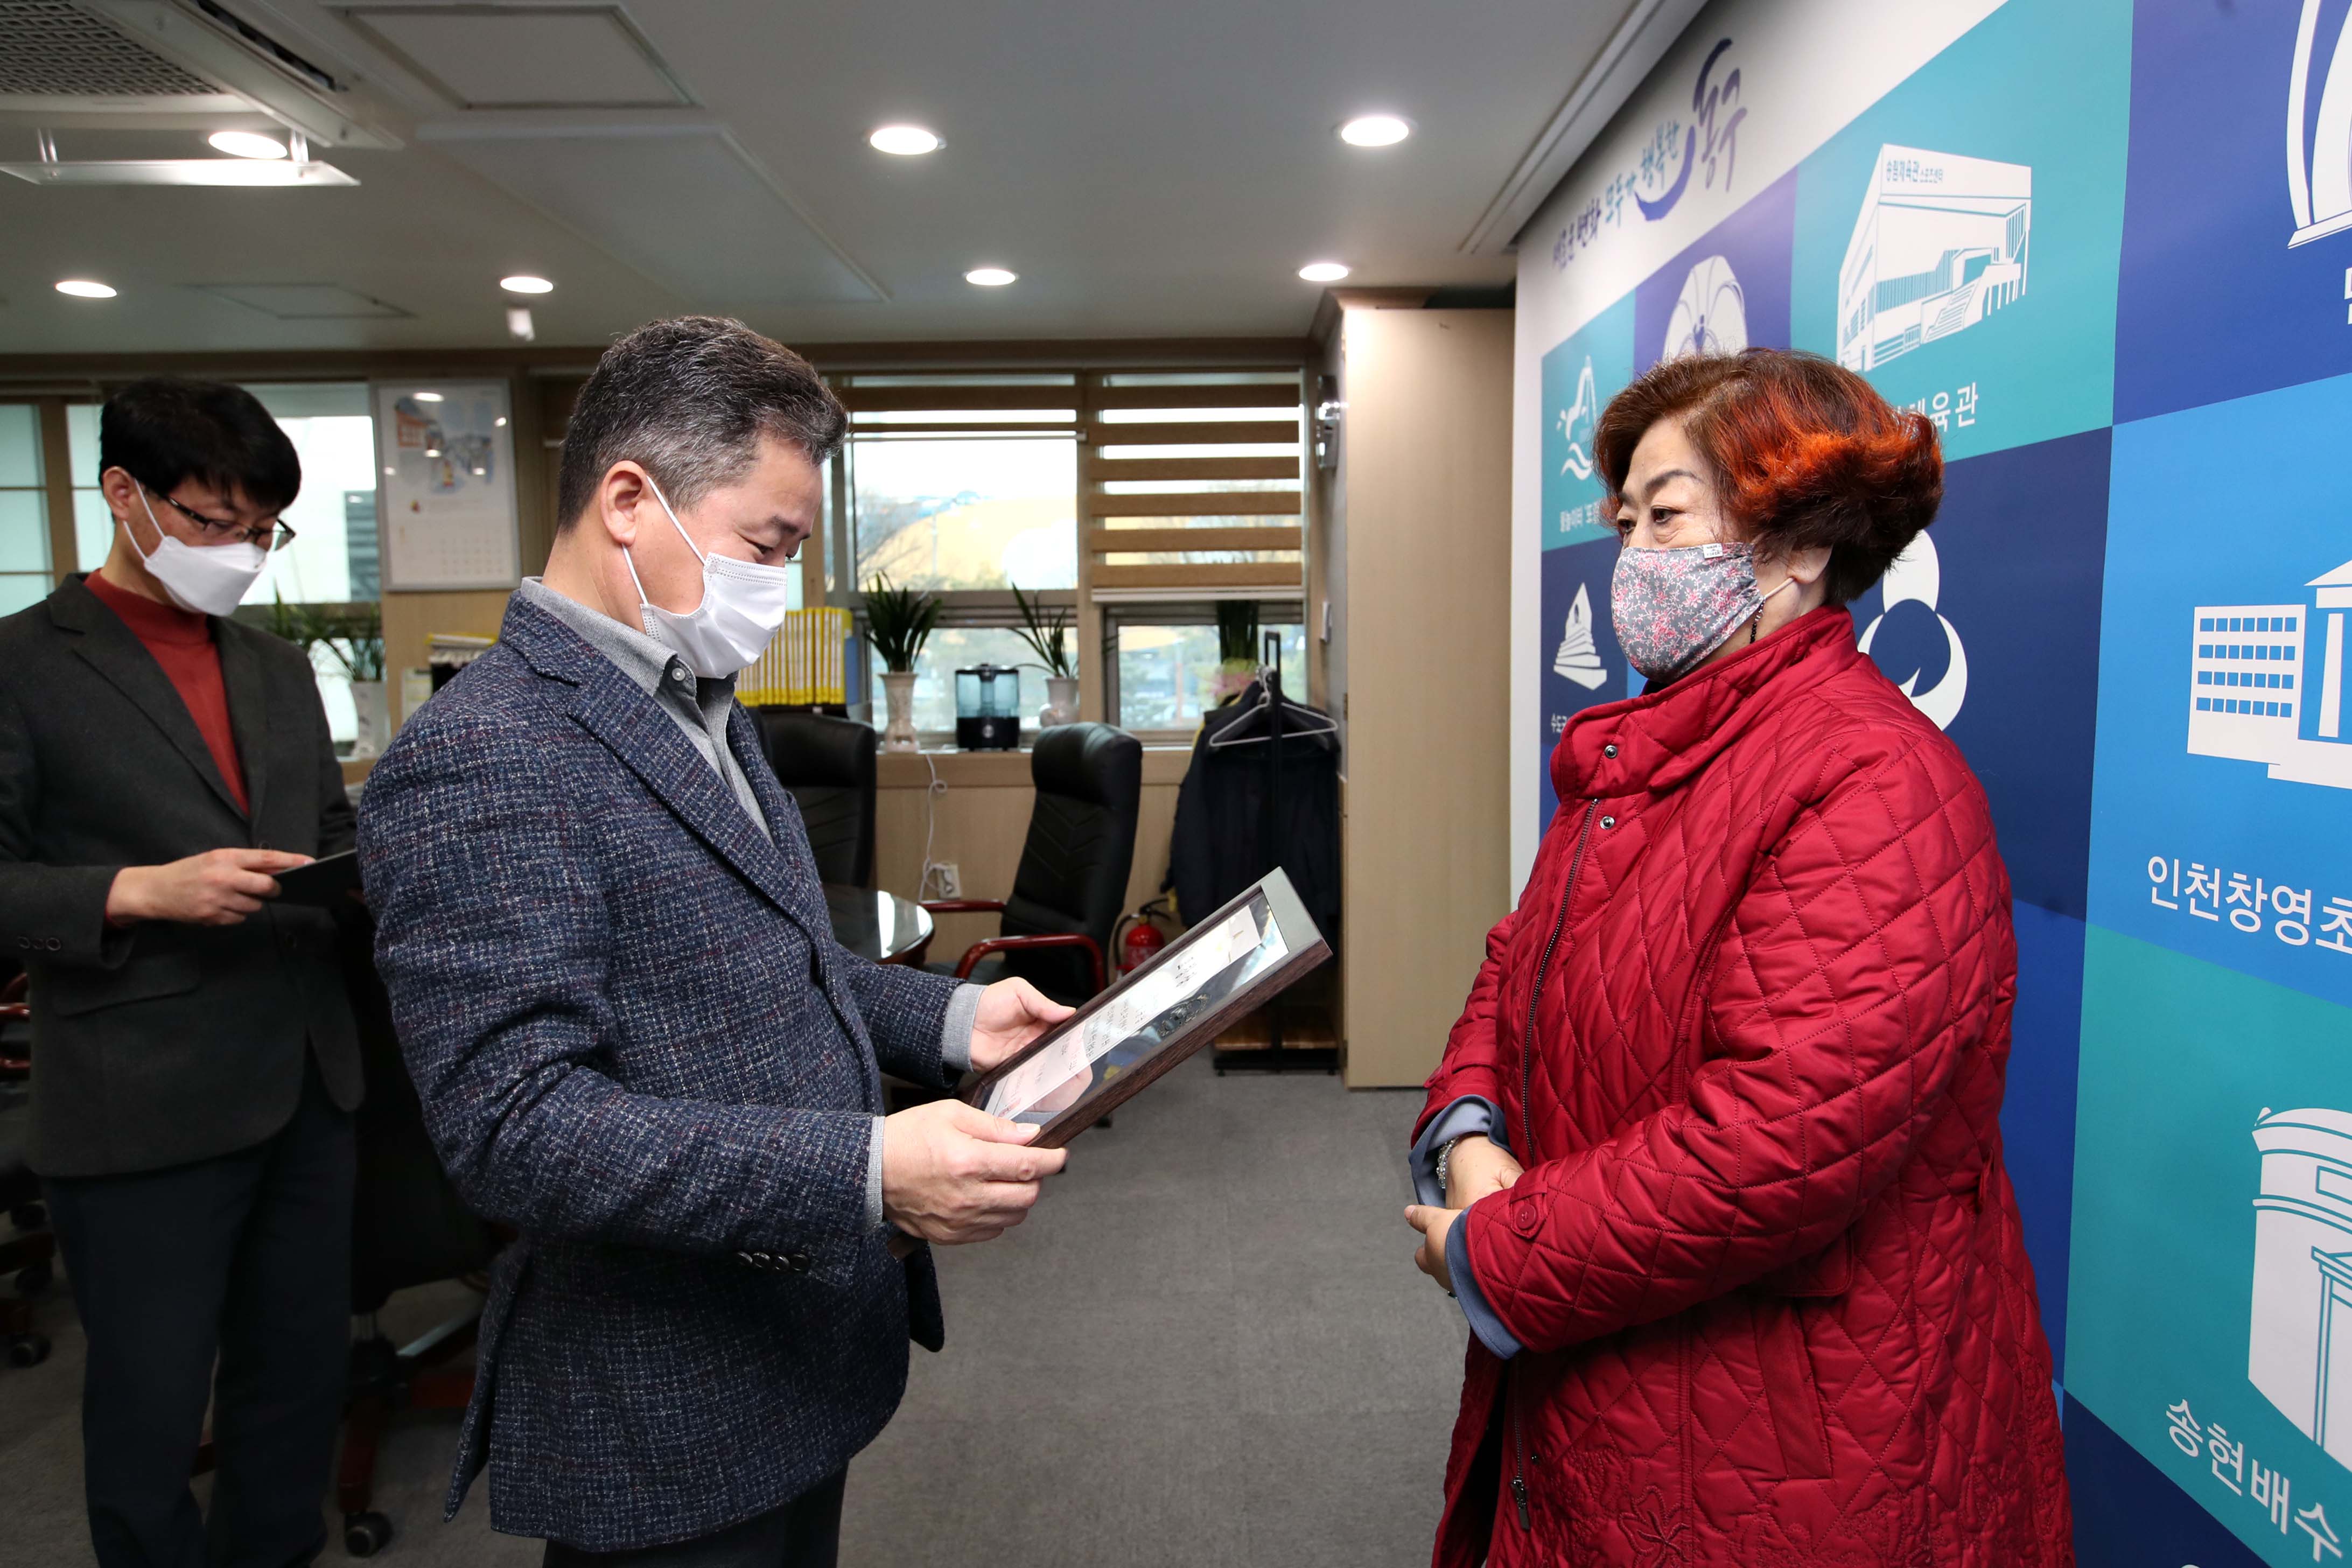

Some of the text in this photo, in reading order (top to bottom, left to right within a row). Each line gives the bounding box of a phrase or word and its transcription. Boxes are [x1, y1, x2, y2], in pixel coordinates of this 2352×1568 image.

[1577, 198, 1601, 248] 변화
[2147, 856, 2352, 956] 인천창영초
[2166, 1398, 2352, 1563] 송현배수
